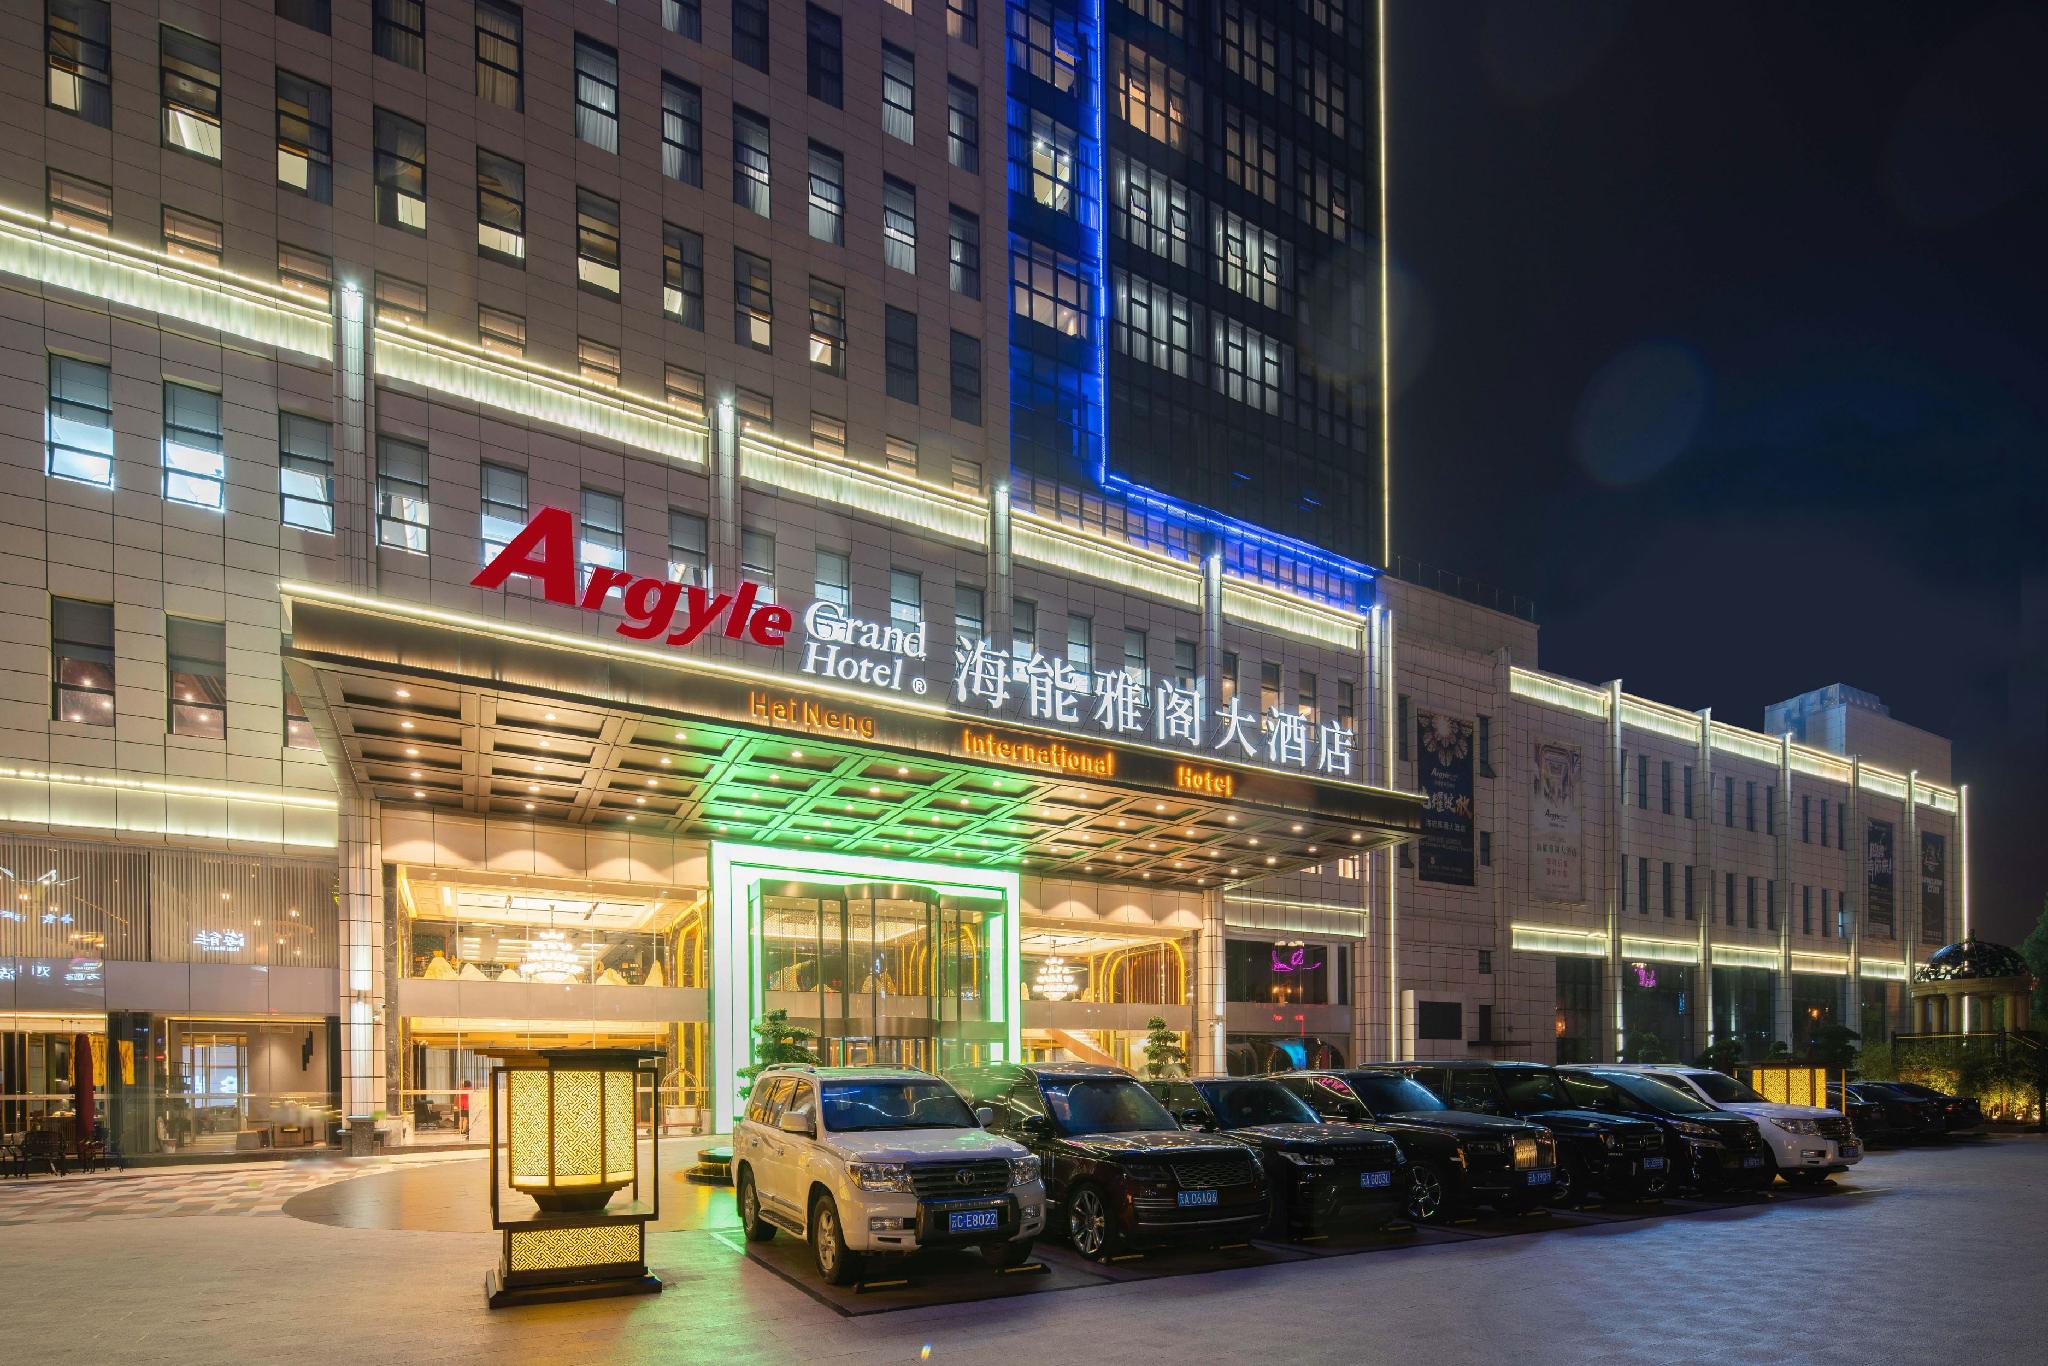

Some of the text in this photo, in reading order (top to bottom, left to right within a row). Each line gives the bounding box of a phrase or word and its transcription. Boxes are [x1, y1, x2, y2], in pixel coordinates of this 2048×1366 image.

[470, 506, 793, 647] Argyle
[804, 600, 927, 661] Grand
[801, 640, 903, 692] Hotel
[954, 635, 1356, 776] 海能雅阁大酒店
[962, 729, 1234, 797] International Hotel
